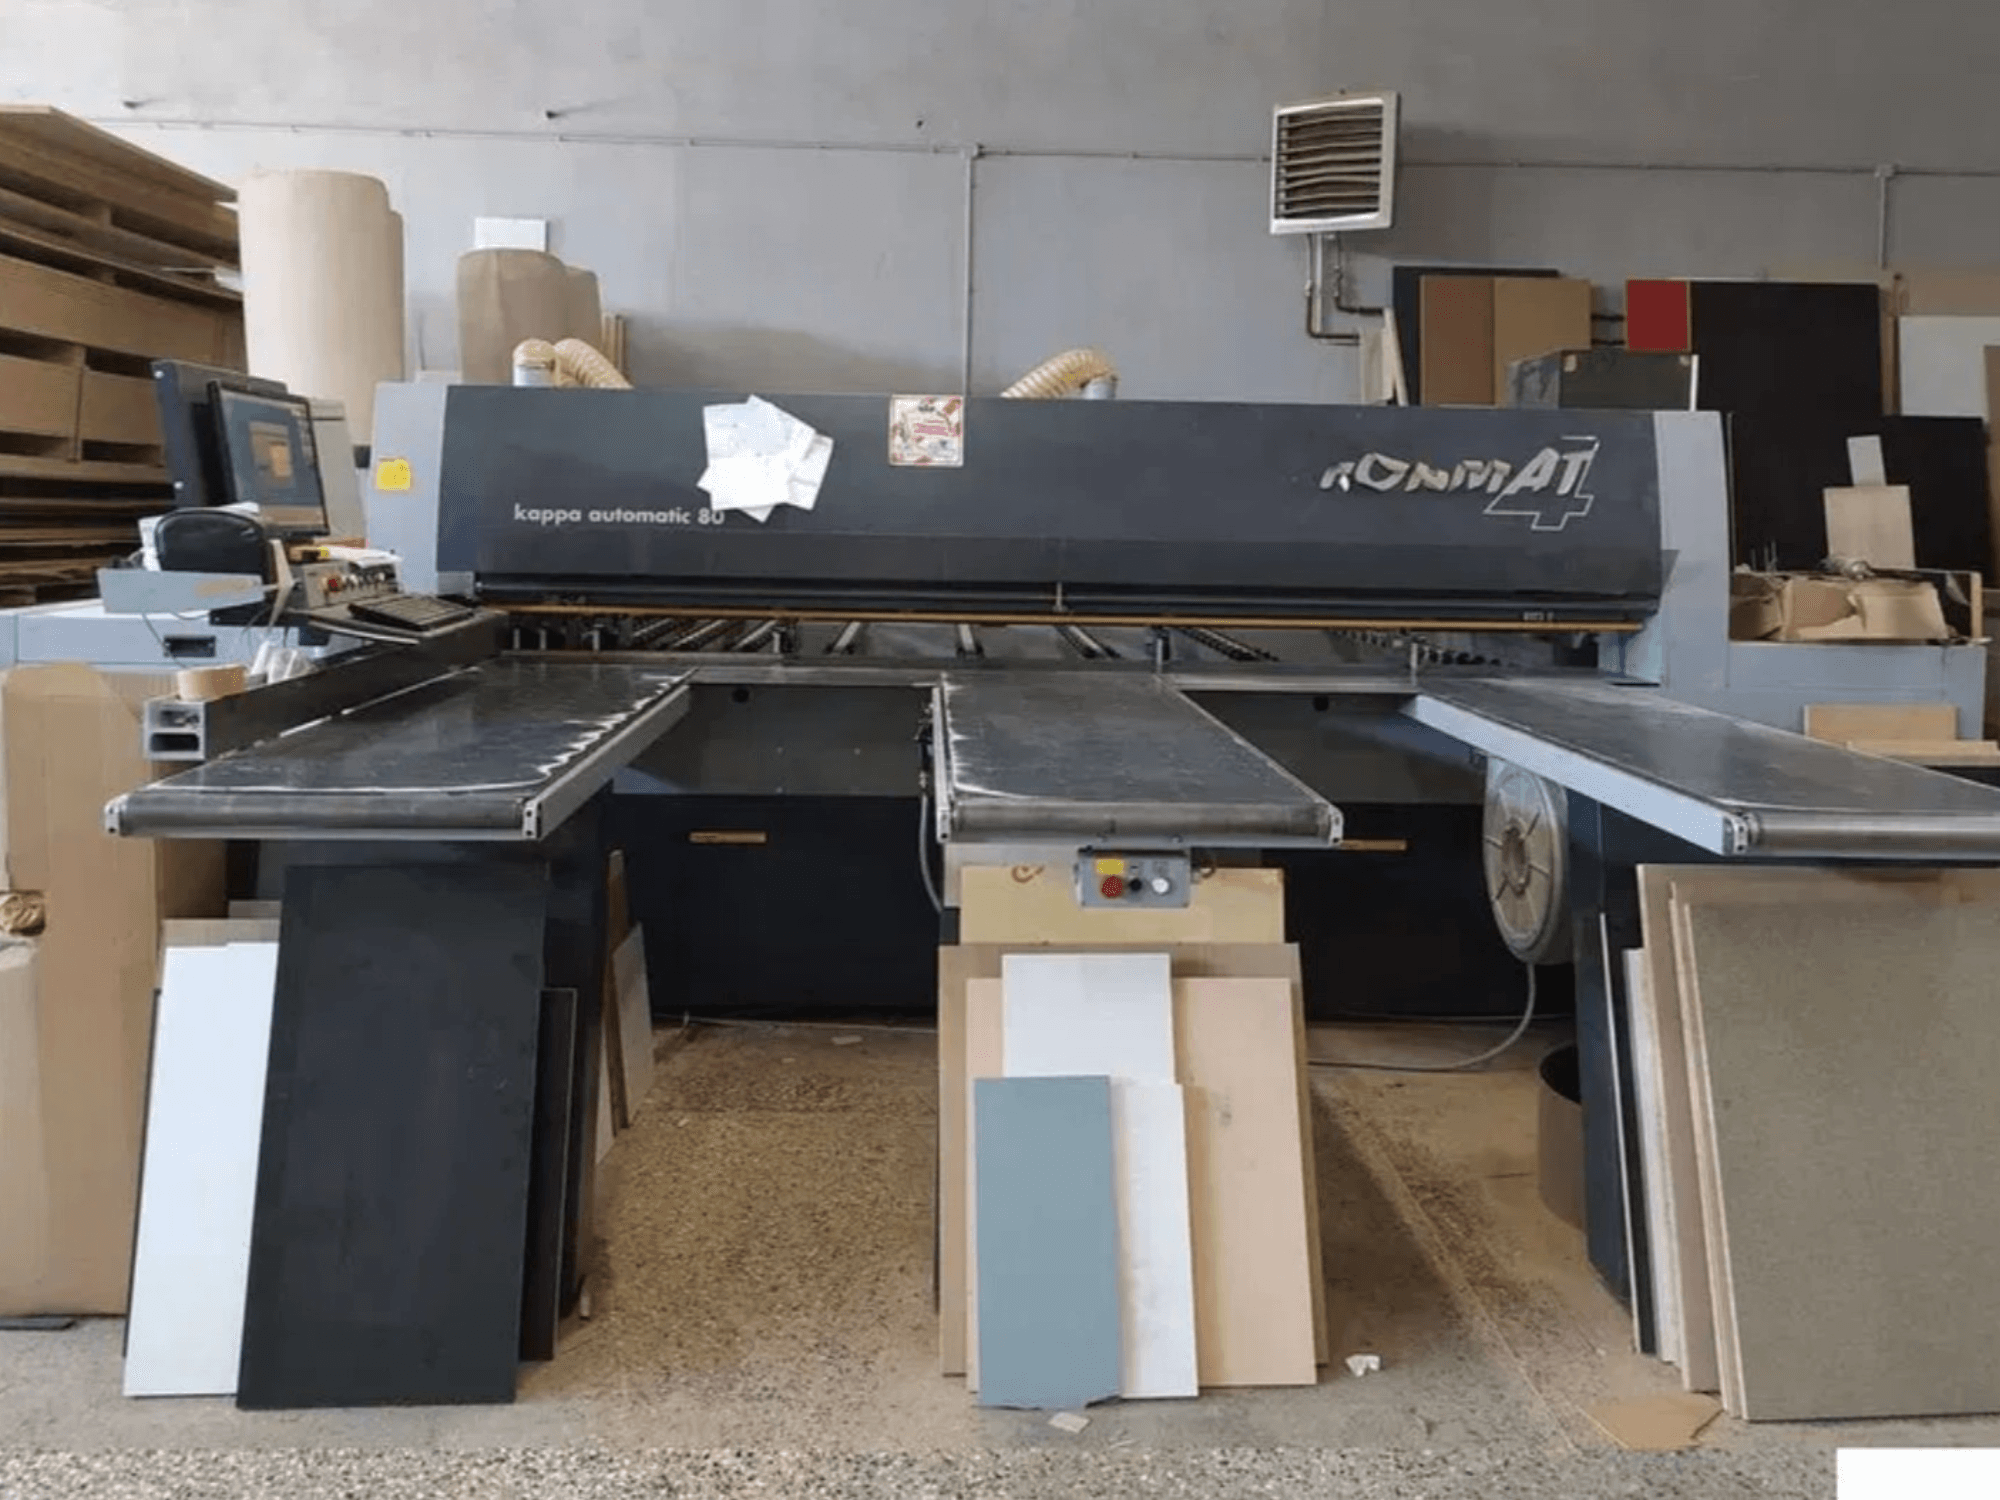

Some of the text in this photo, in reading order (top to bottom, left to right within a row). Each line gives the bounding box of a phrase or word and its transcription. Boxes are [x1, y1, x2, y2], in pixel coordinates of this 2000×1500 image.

[514, 503, 725, 526] kappa automatic 80
